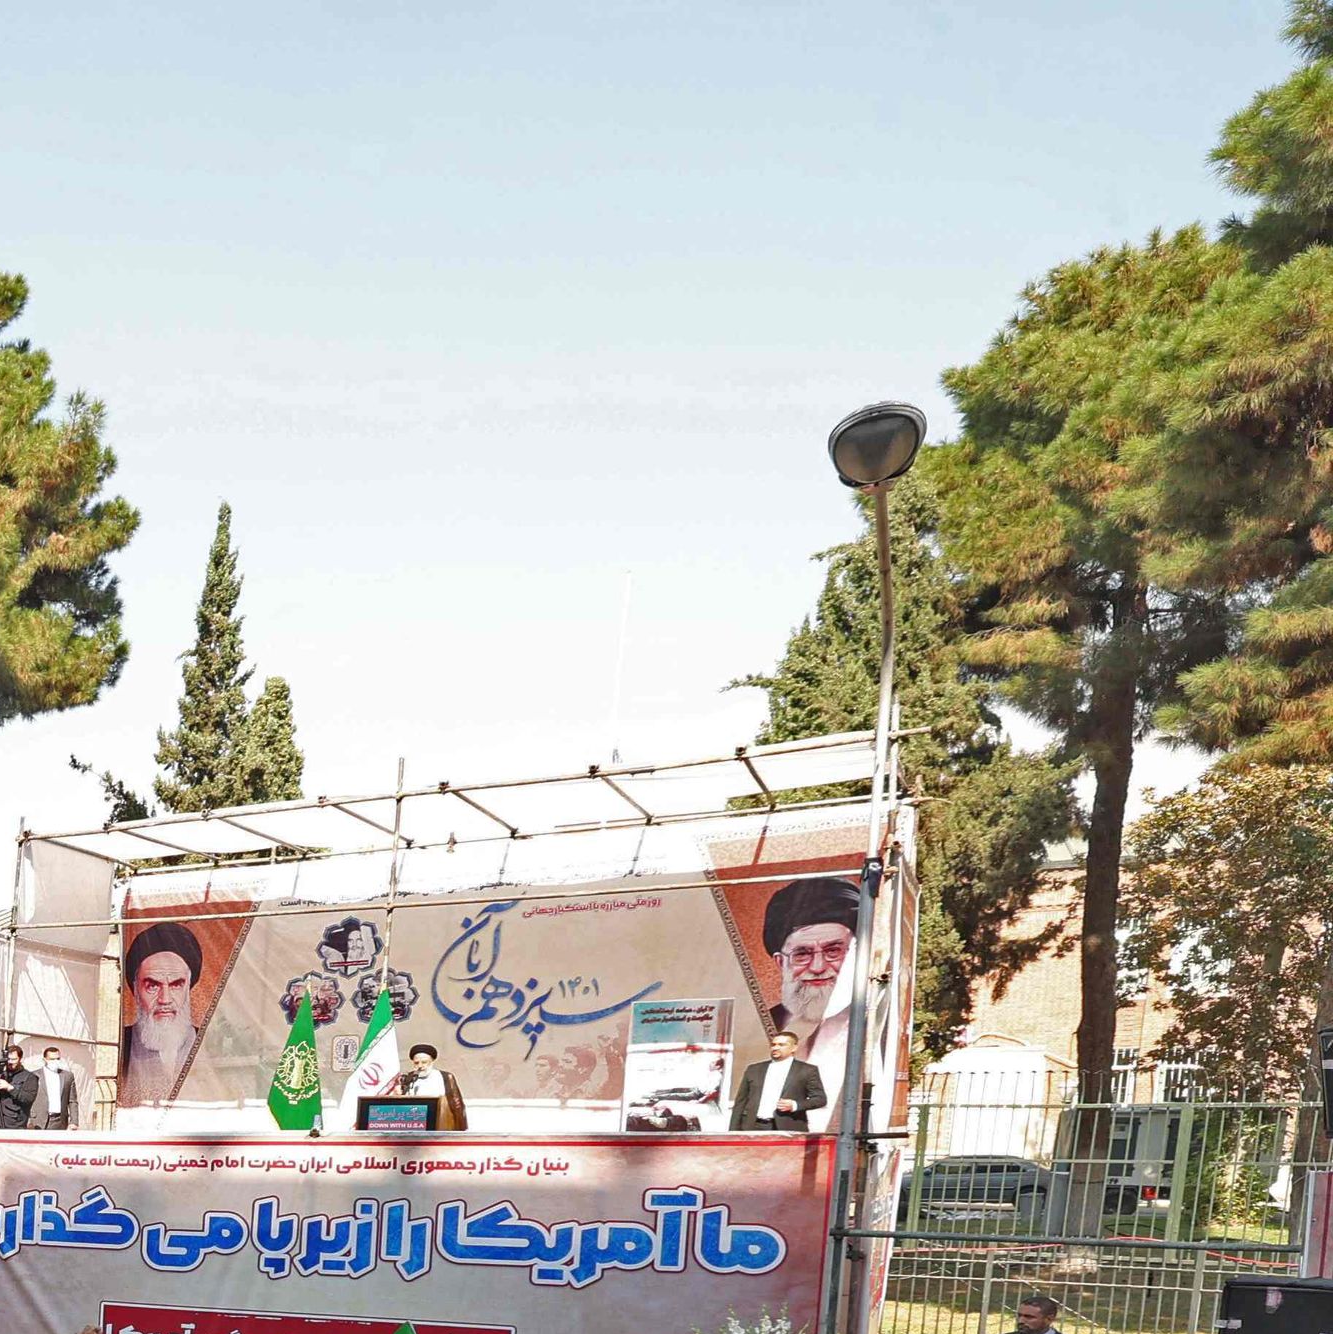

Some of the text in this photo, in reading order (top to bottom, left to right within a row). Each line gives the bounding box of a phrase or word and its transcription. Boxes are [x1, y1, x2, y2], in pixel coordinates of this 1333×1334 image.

[555, 903, 593, 917] استکبار
[558, 977, 600, 998] ۱۴۰۱
[90, 1155, 112, 1167] الله
[164, 1157, 209, 1172] خمینی
[211, 1156, 245, 1171] امام
[248, 1156, 296, 1171] حضرت
[299, 1155, 333, 1174] ایران
[336, 1155, 398, 1175] اسلامی
[400, 1157, 476, 1176] جمهوری
[479, 1155, 523, 1175] گذار
[528, 1159, 570, 1177] بنیان
[143, 1222, 248, 1271] می
[252, 1196, 301, 1277] پا
[296, 1199, 380, 1278] زیر
[381, 1201, 434, 1279] را
[440, 1186, 701, 1288] آمریکا
[694, 1204, 788, 1276] ما
